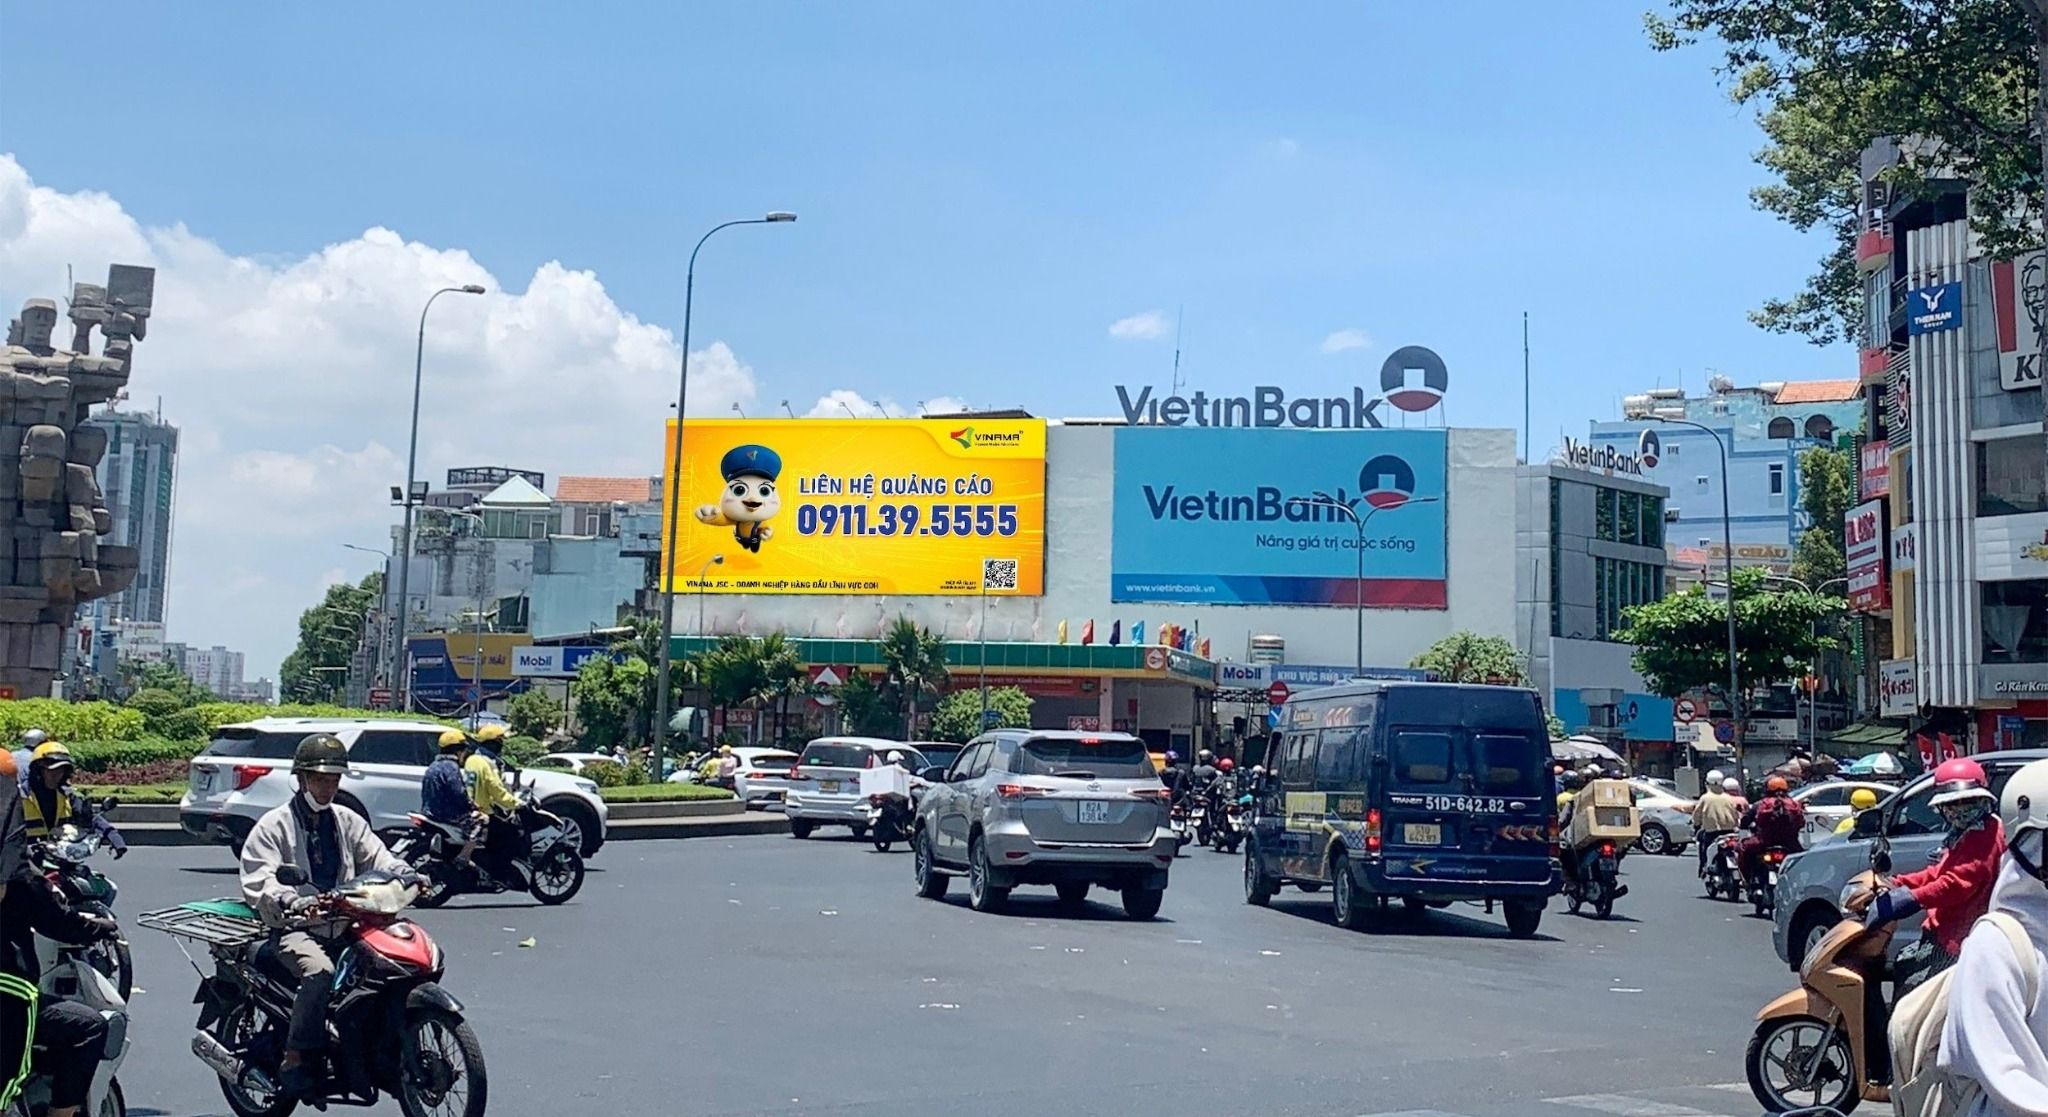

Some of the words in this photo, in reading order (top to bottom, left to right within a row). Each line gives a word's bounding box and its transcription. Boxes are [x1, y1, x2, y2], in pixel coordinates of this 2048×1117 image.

[1115, 385, 1385, 428] VietinBank
[1564, 436, 1643, 476] VietinBank
[800, 473, 842, 495] LIÊN
[850, 473, 874, 501] HỆ
[882, 472, 947, 496] QUẢNG
[955, 473, 993, 496] CÁO
[1142, 484, 1361, 522] VietinBank
[797, 503, 1018, 537] 0911.39.5555
[1256, 533, 1294, 550] Nâng
[1298, 534, 1320, 551] giá
[1324, 535, 1339, 551] trị
[1380, 533, 1416, 552] sống
[1126, 584, 1216, 593] www.vietinbank.vn
[519, 655, 552, 667] Mobil
[1223, 665, 1262, 680] Mobil
[1277, 670, 1297, 681] KHU
